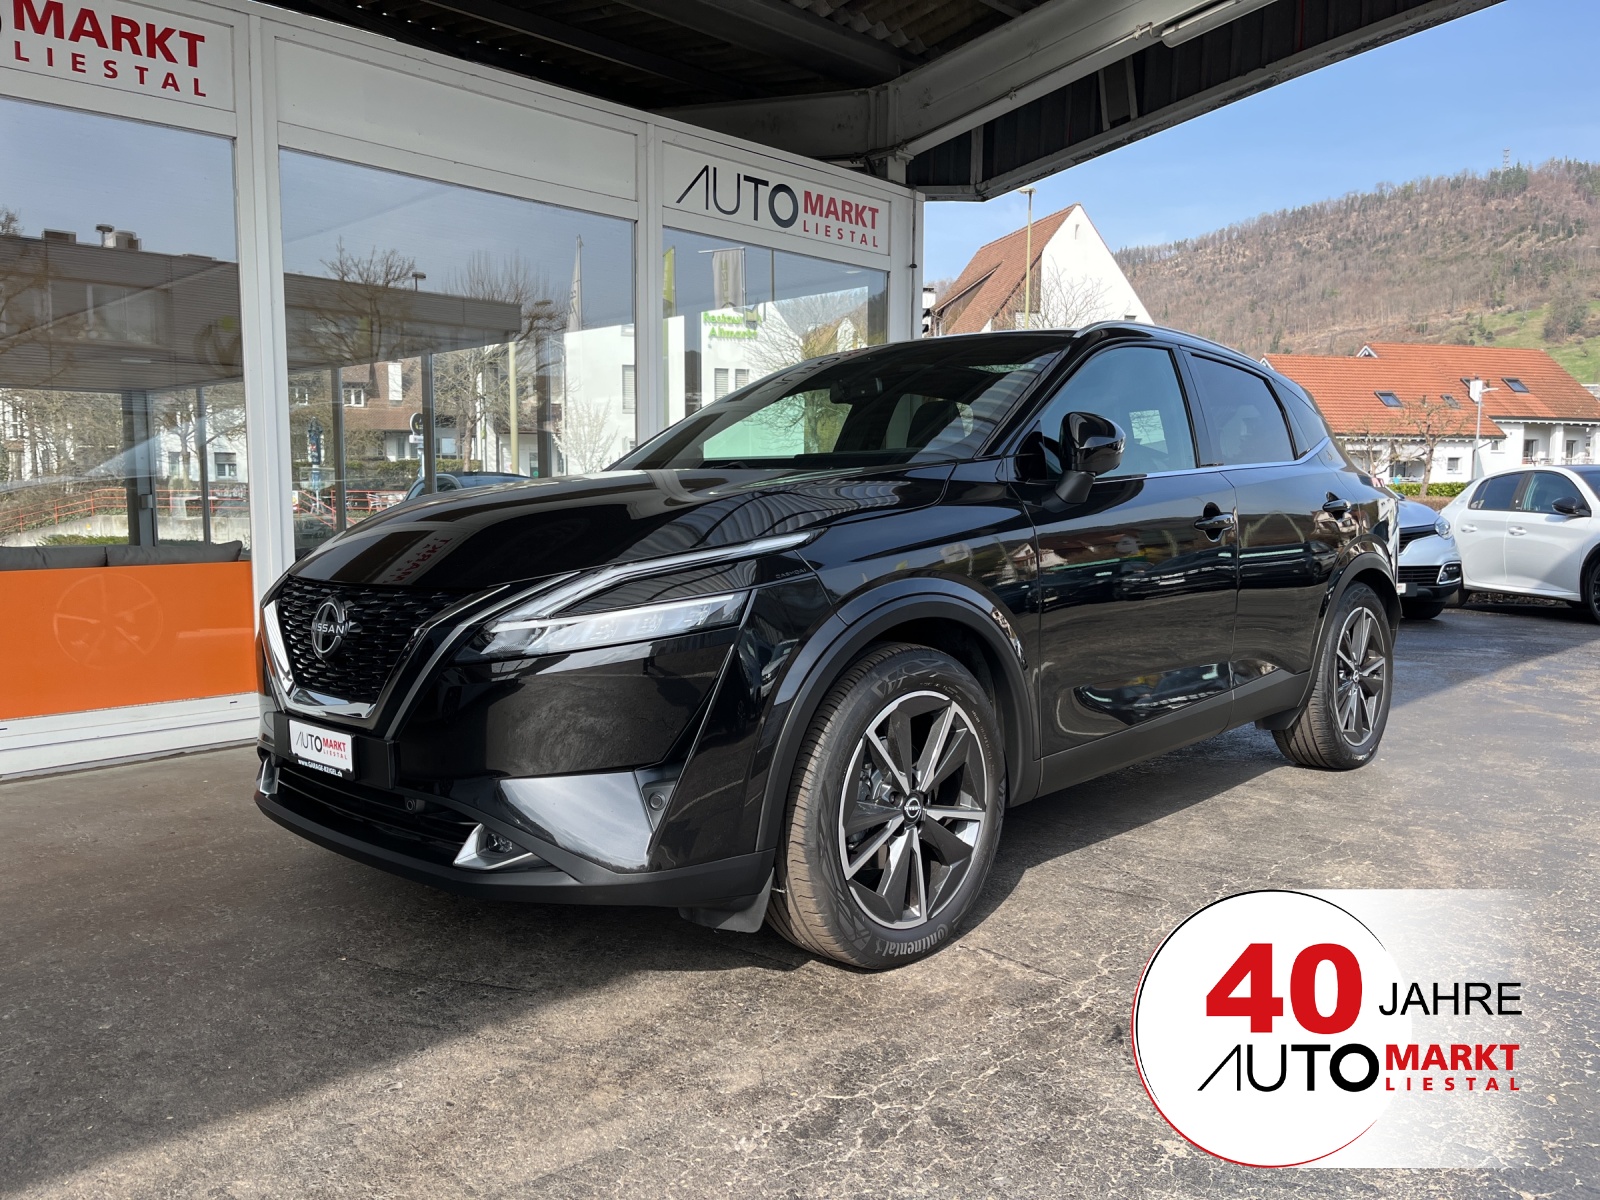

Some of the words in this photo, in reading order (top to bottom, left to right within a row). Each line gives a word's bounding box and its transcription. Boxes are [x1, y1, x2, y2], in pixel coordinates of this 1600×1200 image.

[13, 0, 205, 68] MARKT
[14, 41, 206, 97] LIESTAL
[803, 220, 879, 248] LIESTAL
[323, 750, 347, 760] LIESTAL
[882, 923, 949, 957] Continental
